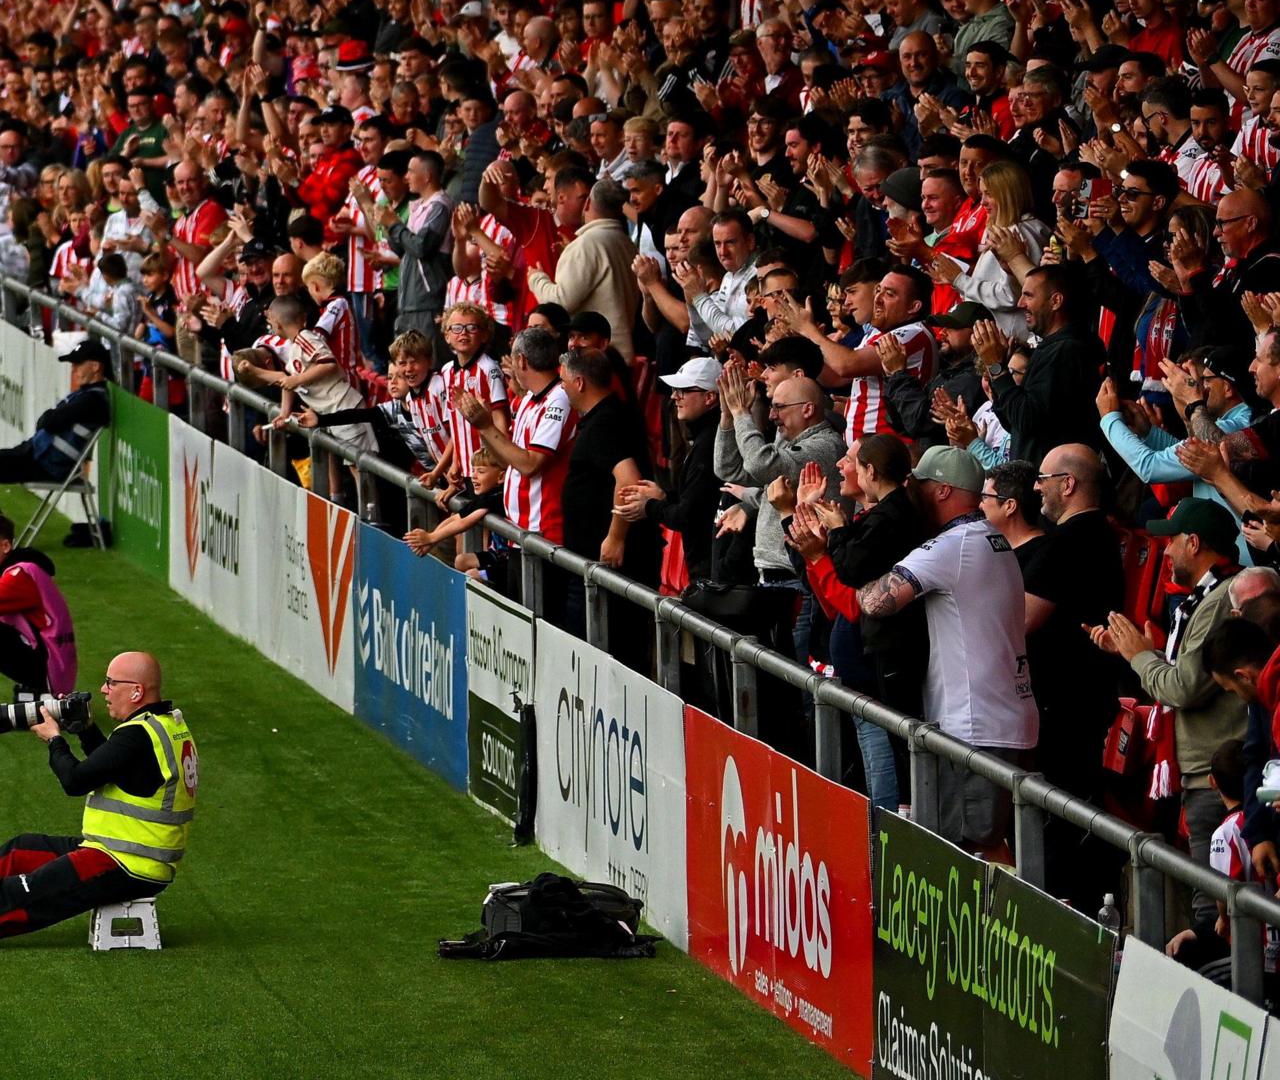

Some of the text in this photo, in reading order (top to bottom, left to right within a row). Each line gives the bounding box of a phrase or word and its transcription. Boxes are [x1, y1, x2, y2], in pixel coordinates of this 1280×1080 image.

[543, 412, 563, 422] CABS
[546, 406, 564, 415] CITY
[200, 478, 240, 577] Diamond
[372, 587, 401, 686] Bank
[401, 607, 416, 696] of
[415, 611, 454, 721] Ireland
[497, 626, 532, 706] Company
[481, 730, 516, 791] SOLICITORS
[754, 768, 833, 979] midas
[877, 830, 1060, 1049] Lacey Solicitors.
[754, 966, 769, 997] sales
[797, 996, 833, 1040] management
[876, 990, 928, 1080] Claims
